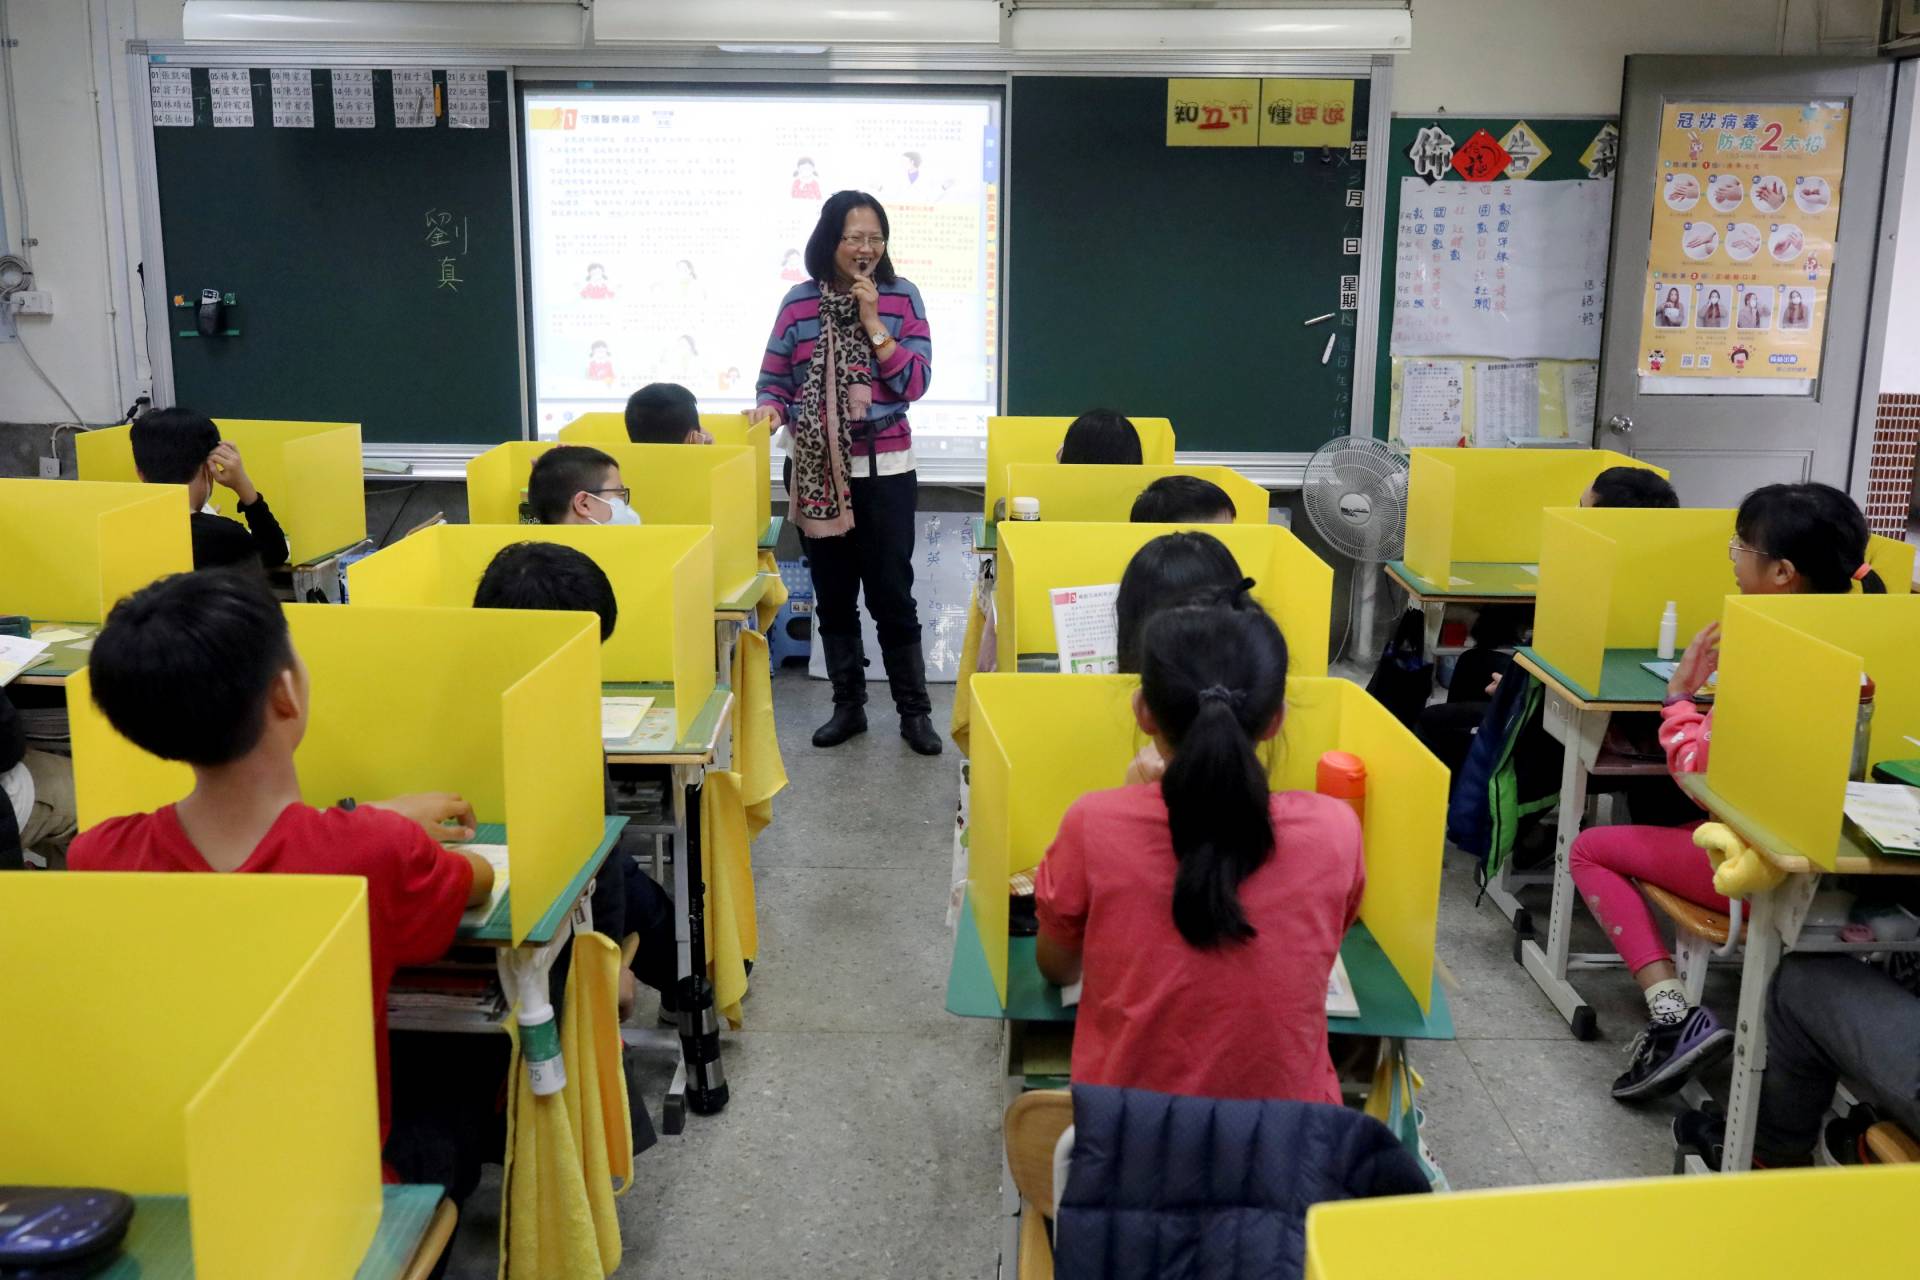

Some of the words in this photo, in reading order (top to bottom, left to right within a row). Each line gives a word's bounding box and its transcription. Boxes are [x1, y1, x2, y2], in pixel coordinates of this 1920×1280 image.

[211, 87, 220, 95] 06
[1677, 112, 1760, 130] 冠狀病毒
[1351, 143, 1367, 159] 年
[1346, 190, 1363, 207] 月
[1345, 239, 1360, 254] 日
[1341, 276, 1357, 309] 星期
